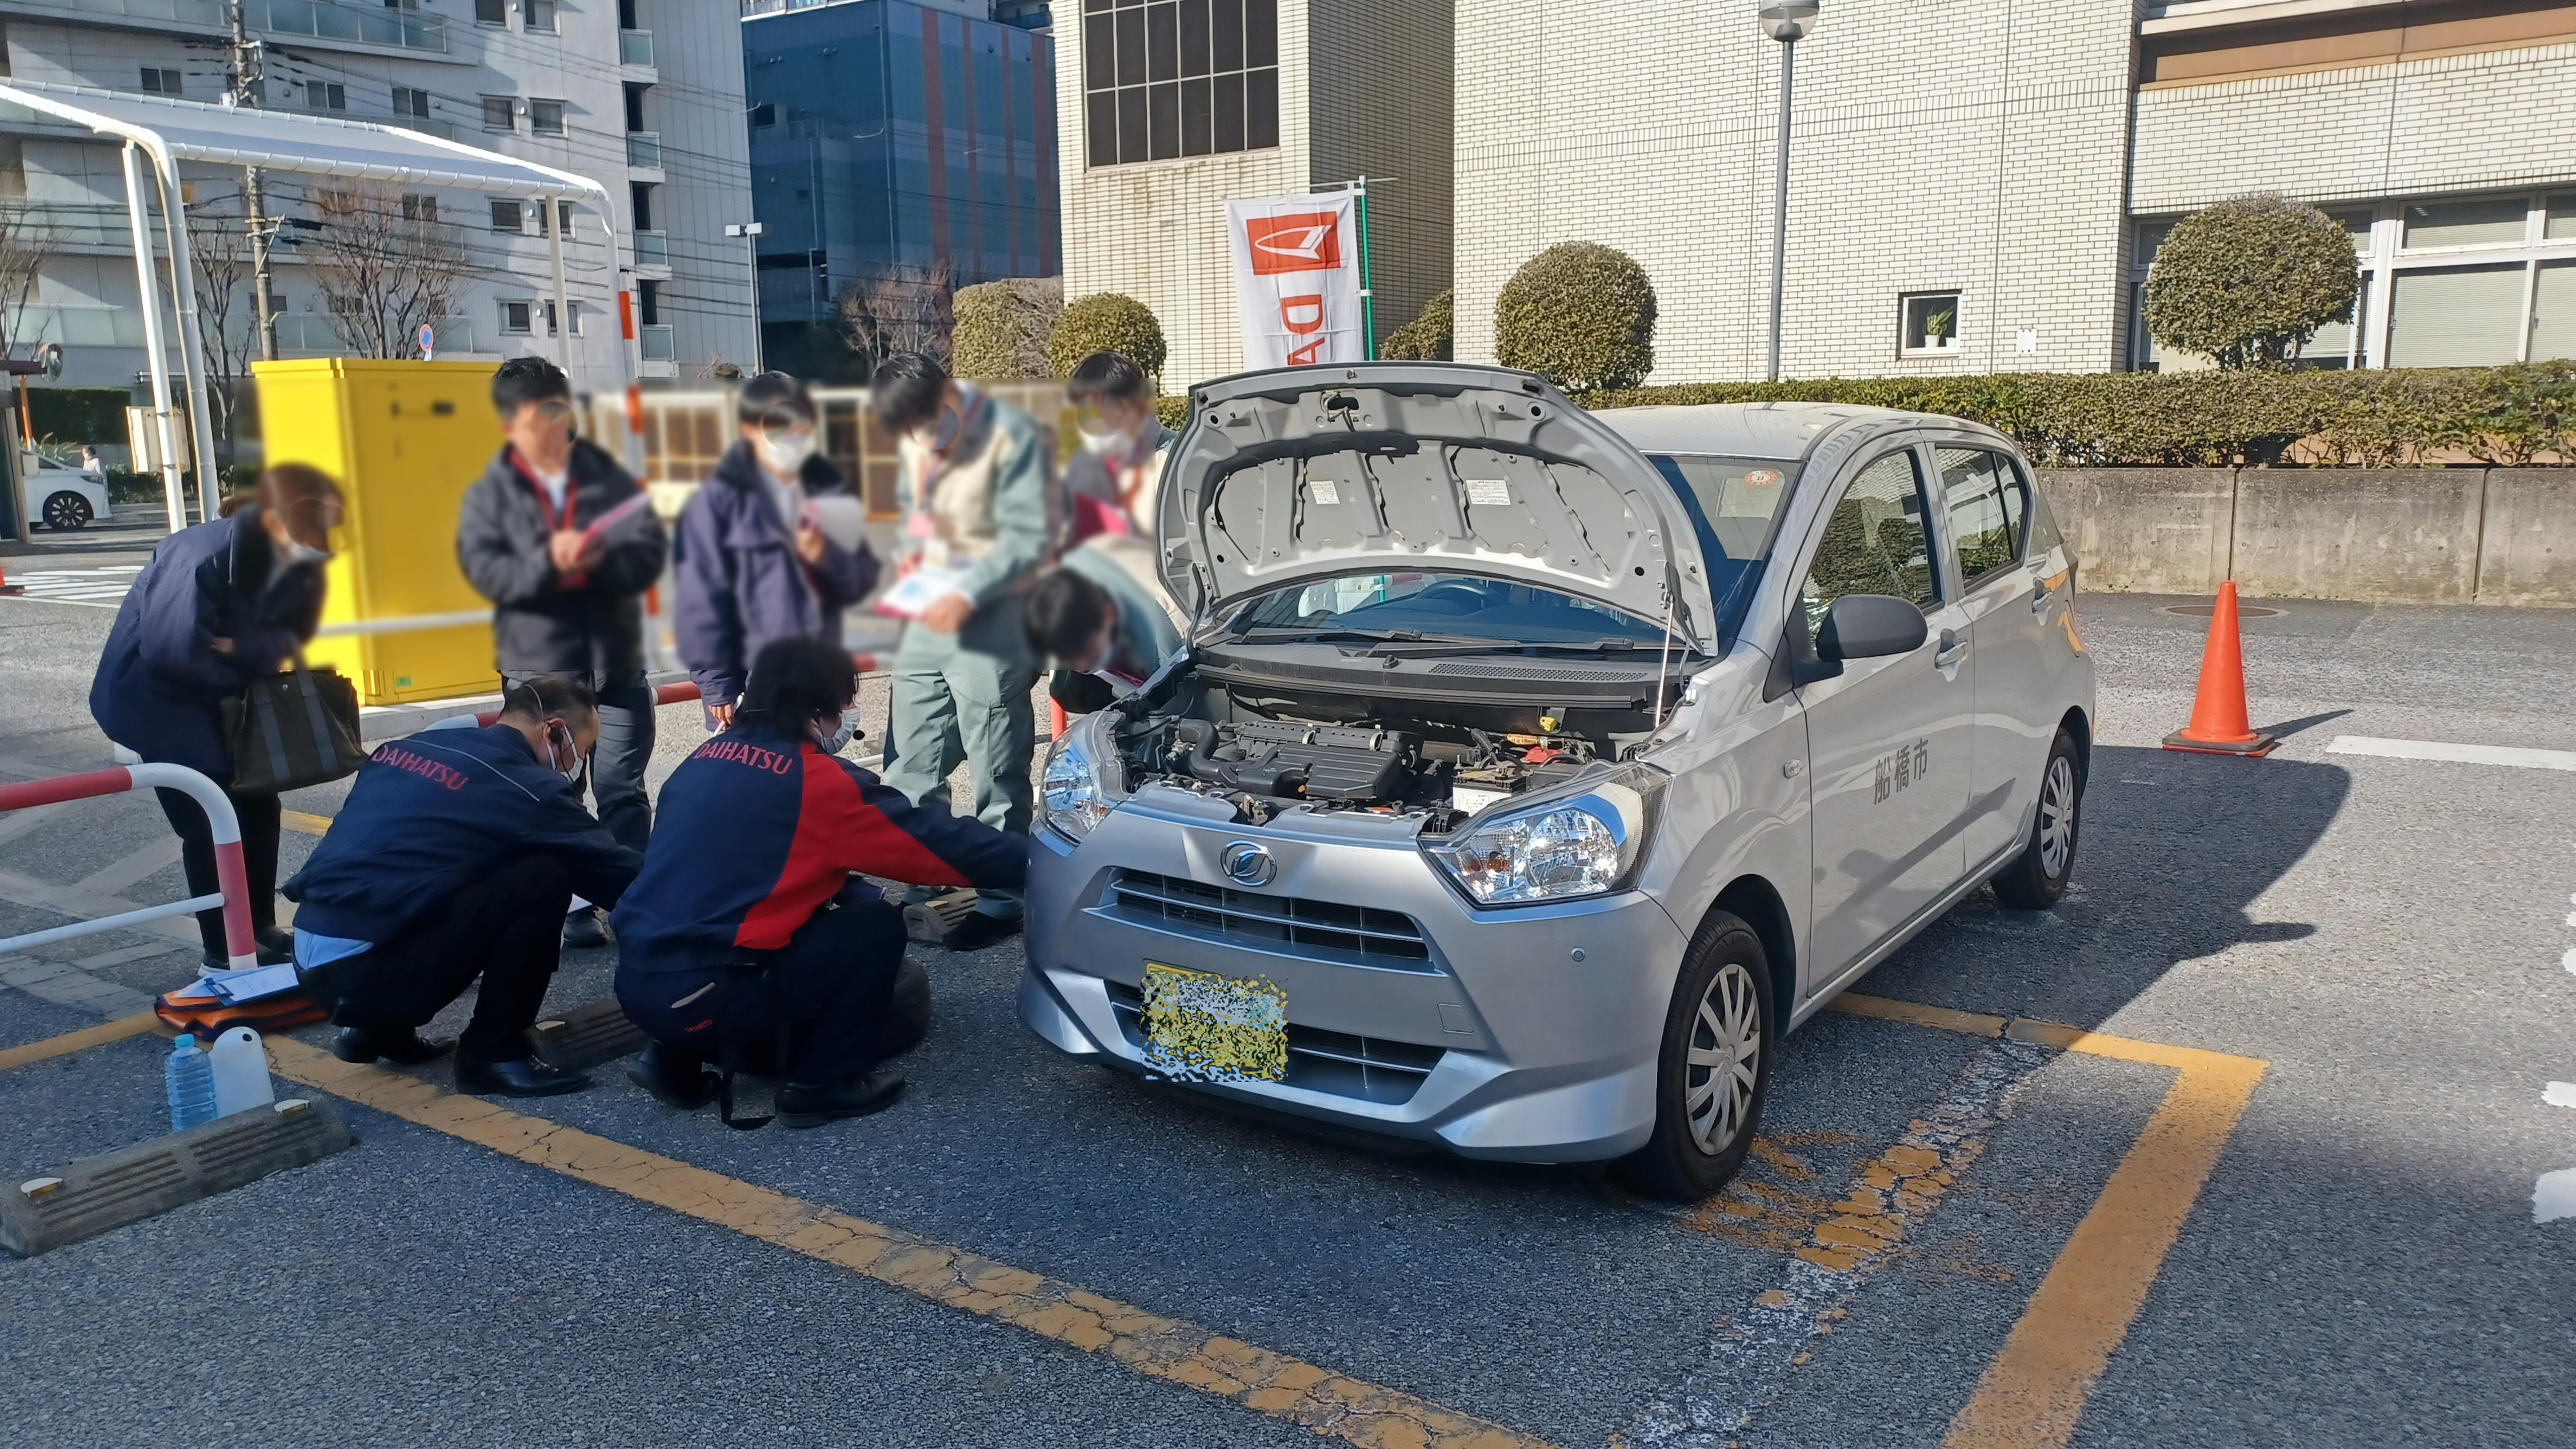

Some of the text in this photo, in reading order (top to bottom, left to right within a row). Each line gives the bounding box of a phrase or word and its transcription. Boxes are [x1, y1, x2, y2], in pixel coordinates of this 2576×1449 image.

[372, 744, 468, 790] DAIHATSU
[693, 741, 793, 775] DAIHATSU
[1874, 738, 1928, 805] 船橋市
